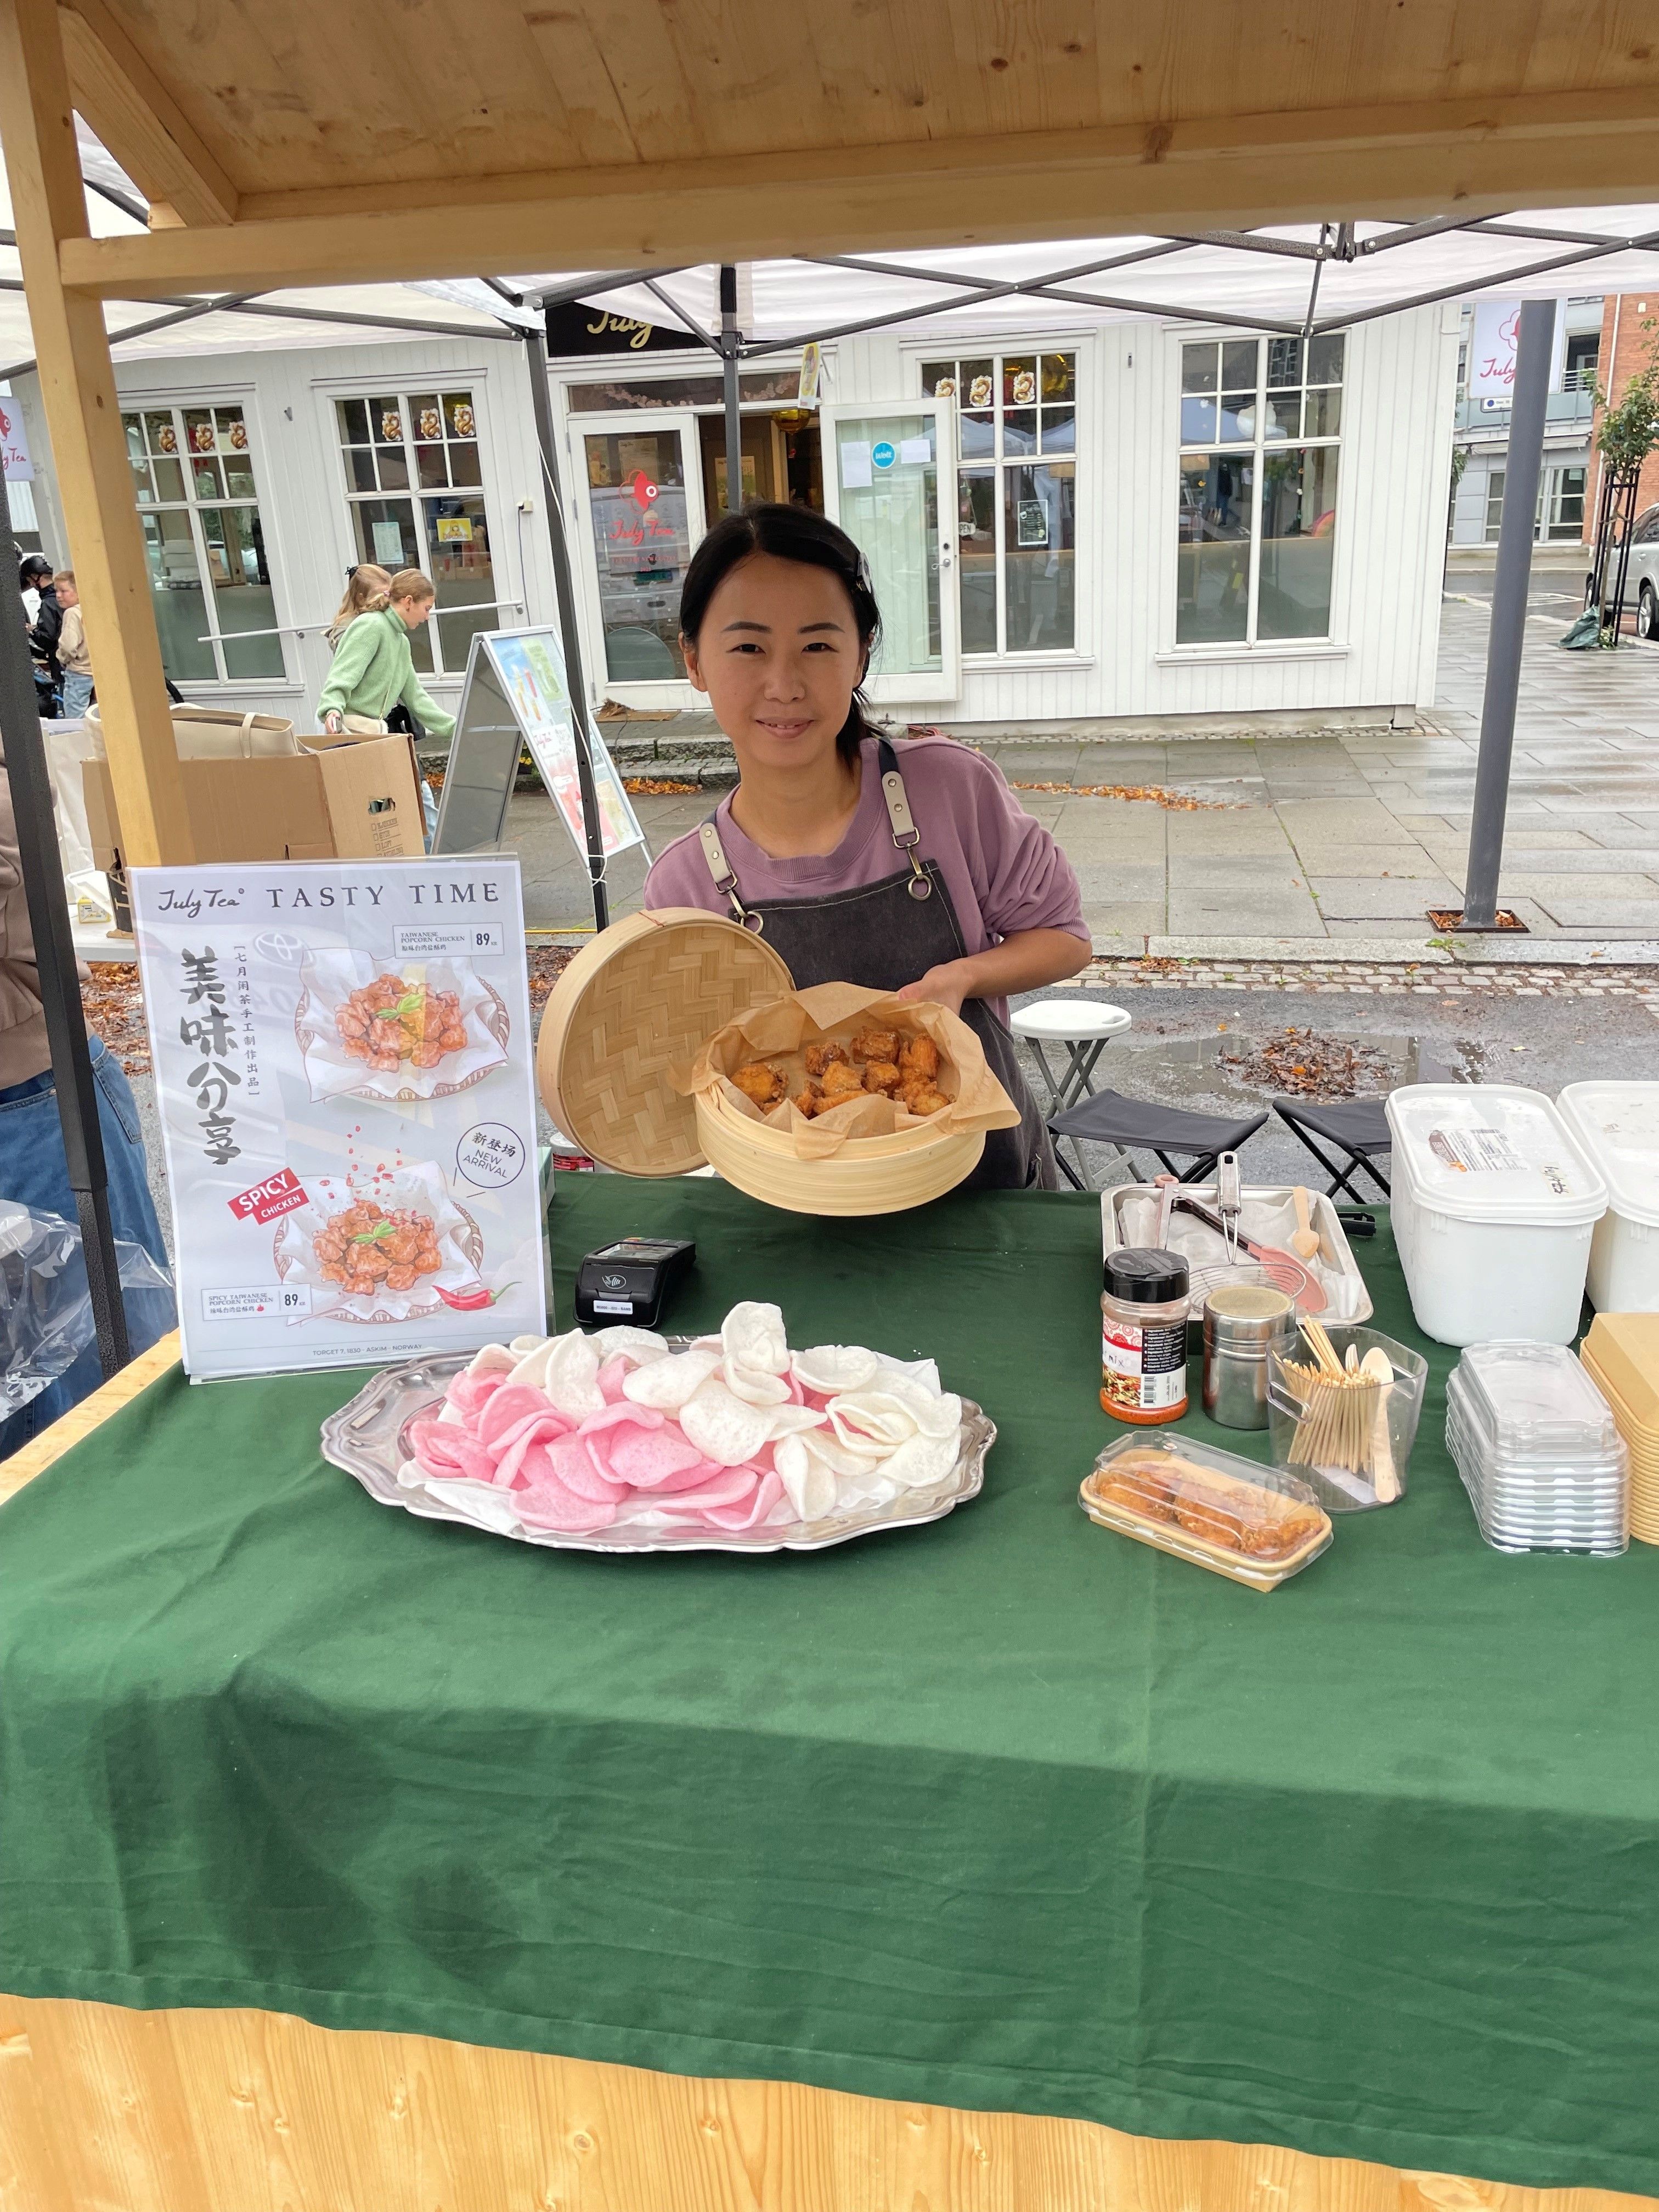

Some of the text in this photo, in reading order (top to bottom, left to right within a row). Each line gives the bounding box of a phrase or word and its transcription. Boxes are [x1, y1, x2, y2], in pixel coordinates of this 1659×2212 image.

[1480, 357, 1516, 384] July
[8, 447, 26, 462] Tea
[608, 519, 645, 546] July
[158, 889, 201, 918] July
[266, 883, 499, 909] TASTY TIME
[476, 933, 490, 946] 89
[180, 945, 241, 1165] 美味分享
[472, 1132, 516, 1157] 新登场
[475, 1149, 502, 1164] NEW
[463, 1155, 507, 1178] ARRIVAL
[239, 1173, 289, 1211] SPICY
[261, 1194, 301, 1217] CHICKEN
[284, 1294, 298, 1306] 89
